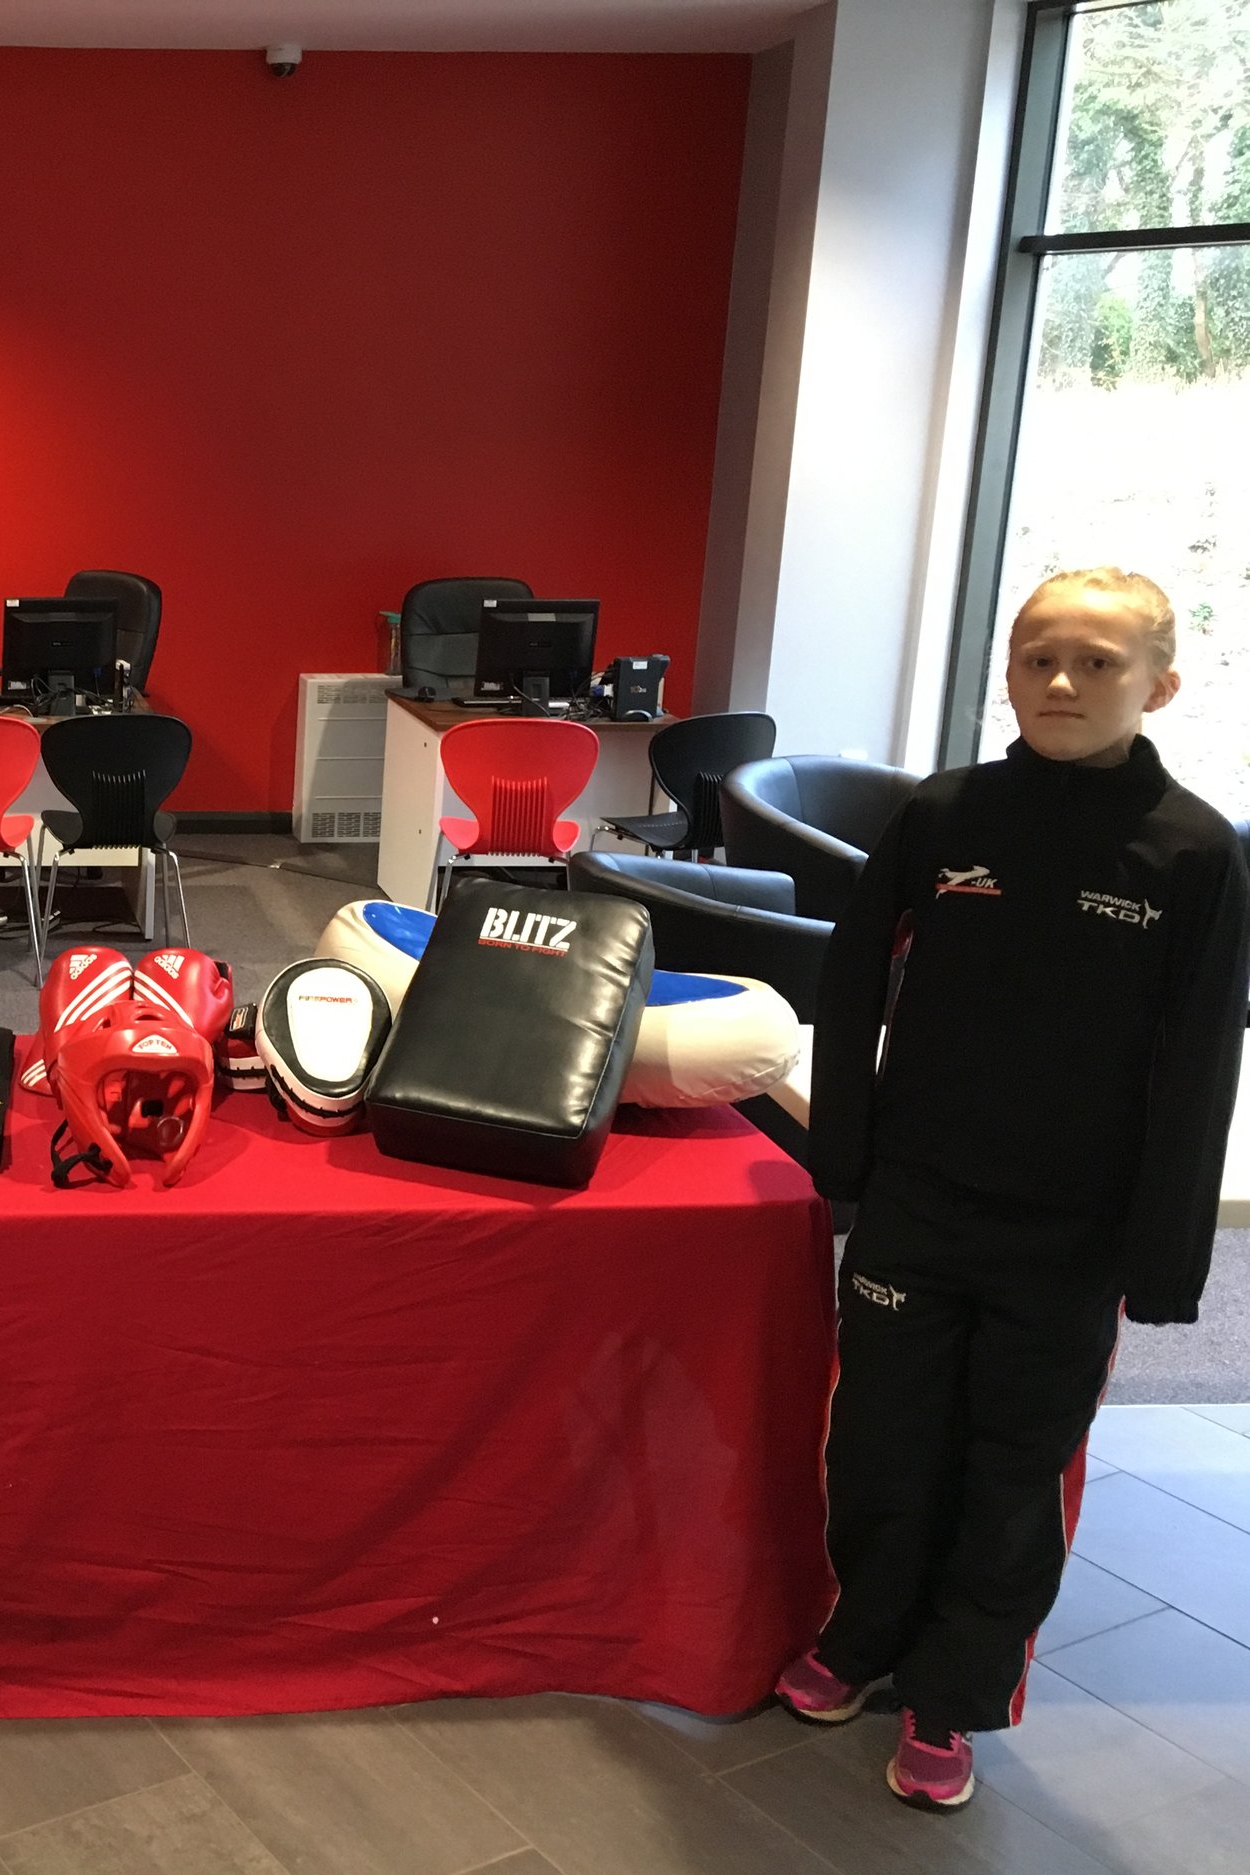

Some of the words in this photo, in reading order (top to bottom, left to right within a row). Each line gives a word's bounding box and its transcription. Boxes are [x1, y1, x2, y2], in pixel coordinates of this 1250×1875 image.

[1077, 900, 1141, 924] TKD
[1080, 890, 1142, 912] WARWICK
[480, 907, 578, 950] BLITZ
[477, 938, 512, 949] BORN
[515, 943, 530, 952] TO
[531, 945, 566, 958] FIGHT
[852, 1277, 890, 1306] TKD
